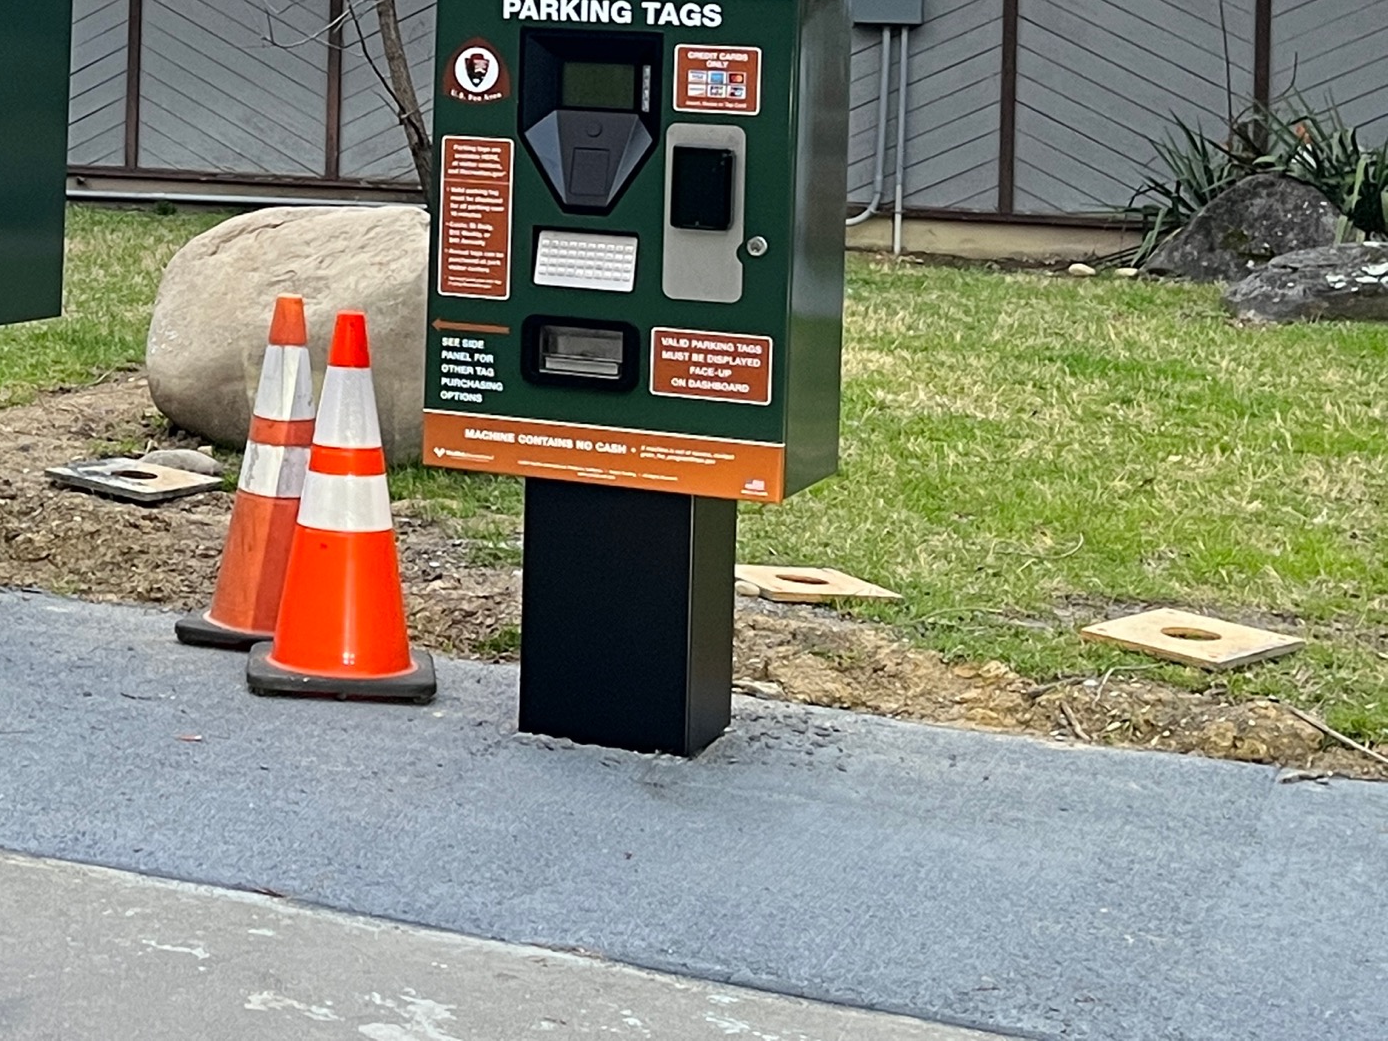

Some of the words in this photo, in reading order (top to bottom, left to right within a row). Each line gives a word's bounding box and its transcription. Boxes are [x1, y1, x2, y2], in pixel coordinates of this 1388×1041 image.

[641, 1, 722, 27] TAGS
[687, 51, 718, 60] CREDIT
[719, 52, 748, 62] CARDS
[706, 60, 729, 68] ONLY
[442, 337, 460, 347] SEE
[462, 339, 484, 349] SIDE
[661, 337, 689, 348] VALID
[692, 339, 734, 352] PARKING
[736, 343, 762, 354] TAGS
[441, 350, 472, 361] PANEL
[474, 353, 494, 363] FOR
[661, 351, 690, 361] MUST
[692, 353, 705, 362] BE
[707, 355, 761, 367] DISPLAYED
[441, 364, 474, 375] OTHER
[475, 367, 494, 377] TAG
[689, 366, 732, 377] FACE-UP
[441, 377, 504, 391] PURCHASING
[671, 378, 687, 387] ON
[688, 379, 750, 393] DASHBOARD
[440, 390, 483, 403] OPTIONS
[464, 428, 515, 443] MACHINE
[518, 434, 573, 449] CONTAINS
[576, 440, 592, 451] NO
[595, 442, 626, 454] CASH
